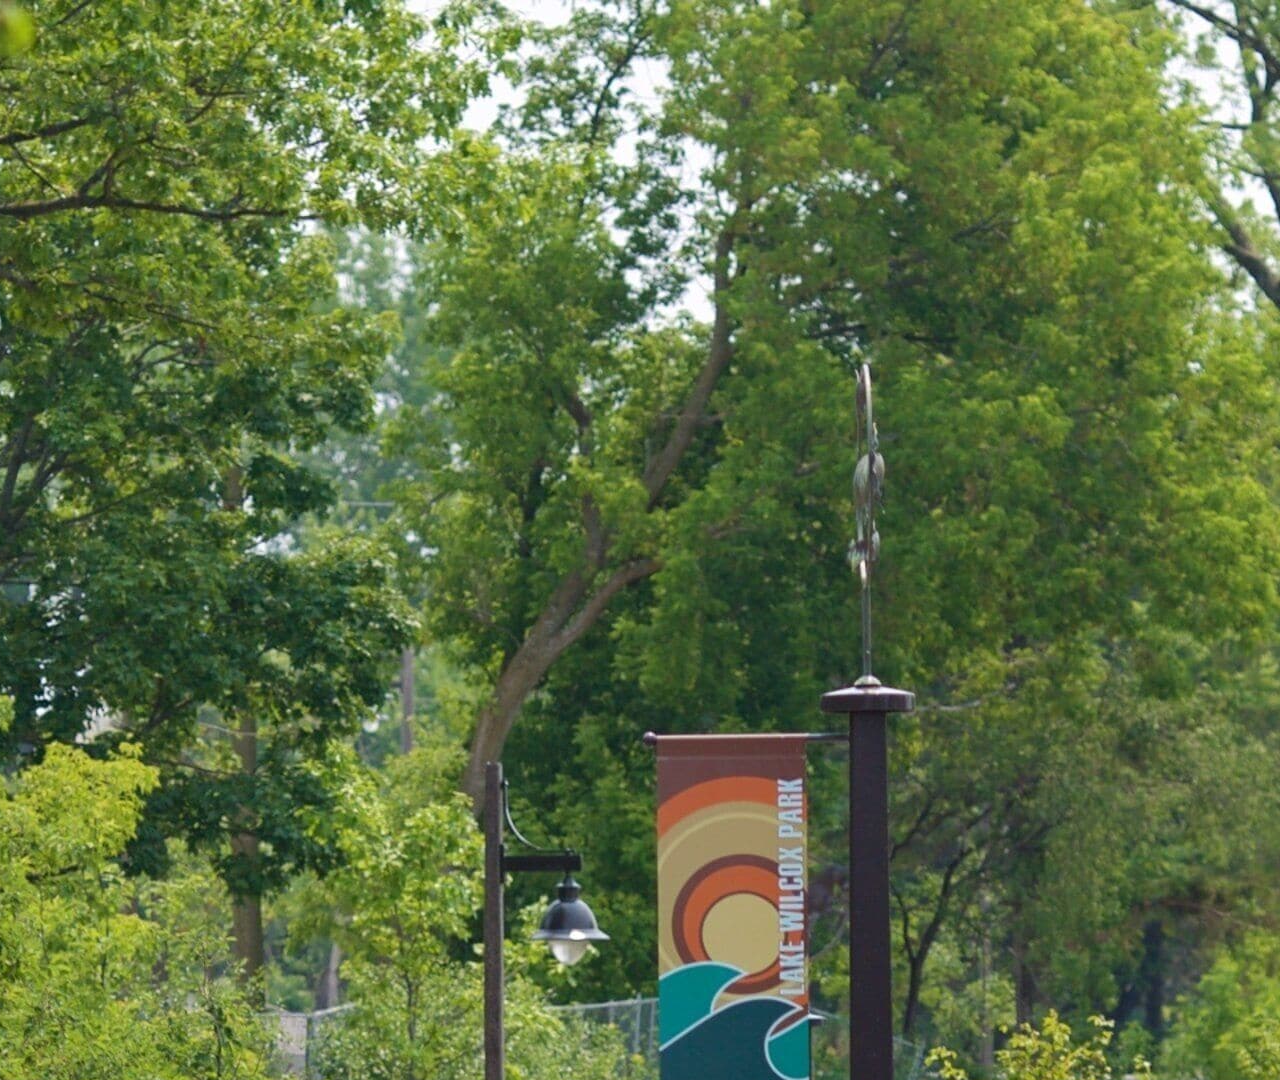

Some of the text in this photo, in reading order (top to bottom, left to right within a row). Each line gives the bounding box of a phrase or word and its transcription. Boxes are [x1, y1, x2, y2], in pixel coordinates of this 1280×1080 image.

[777, 778, 805, 995] LAKE WILCOX PARK
